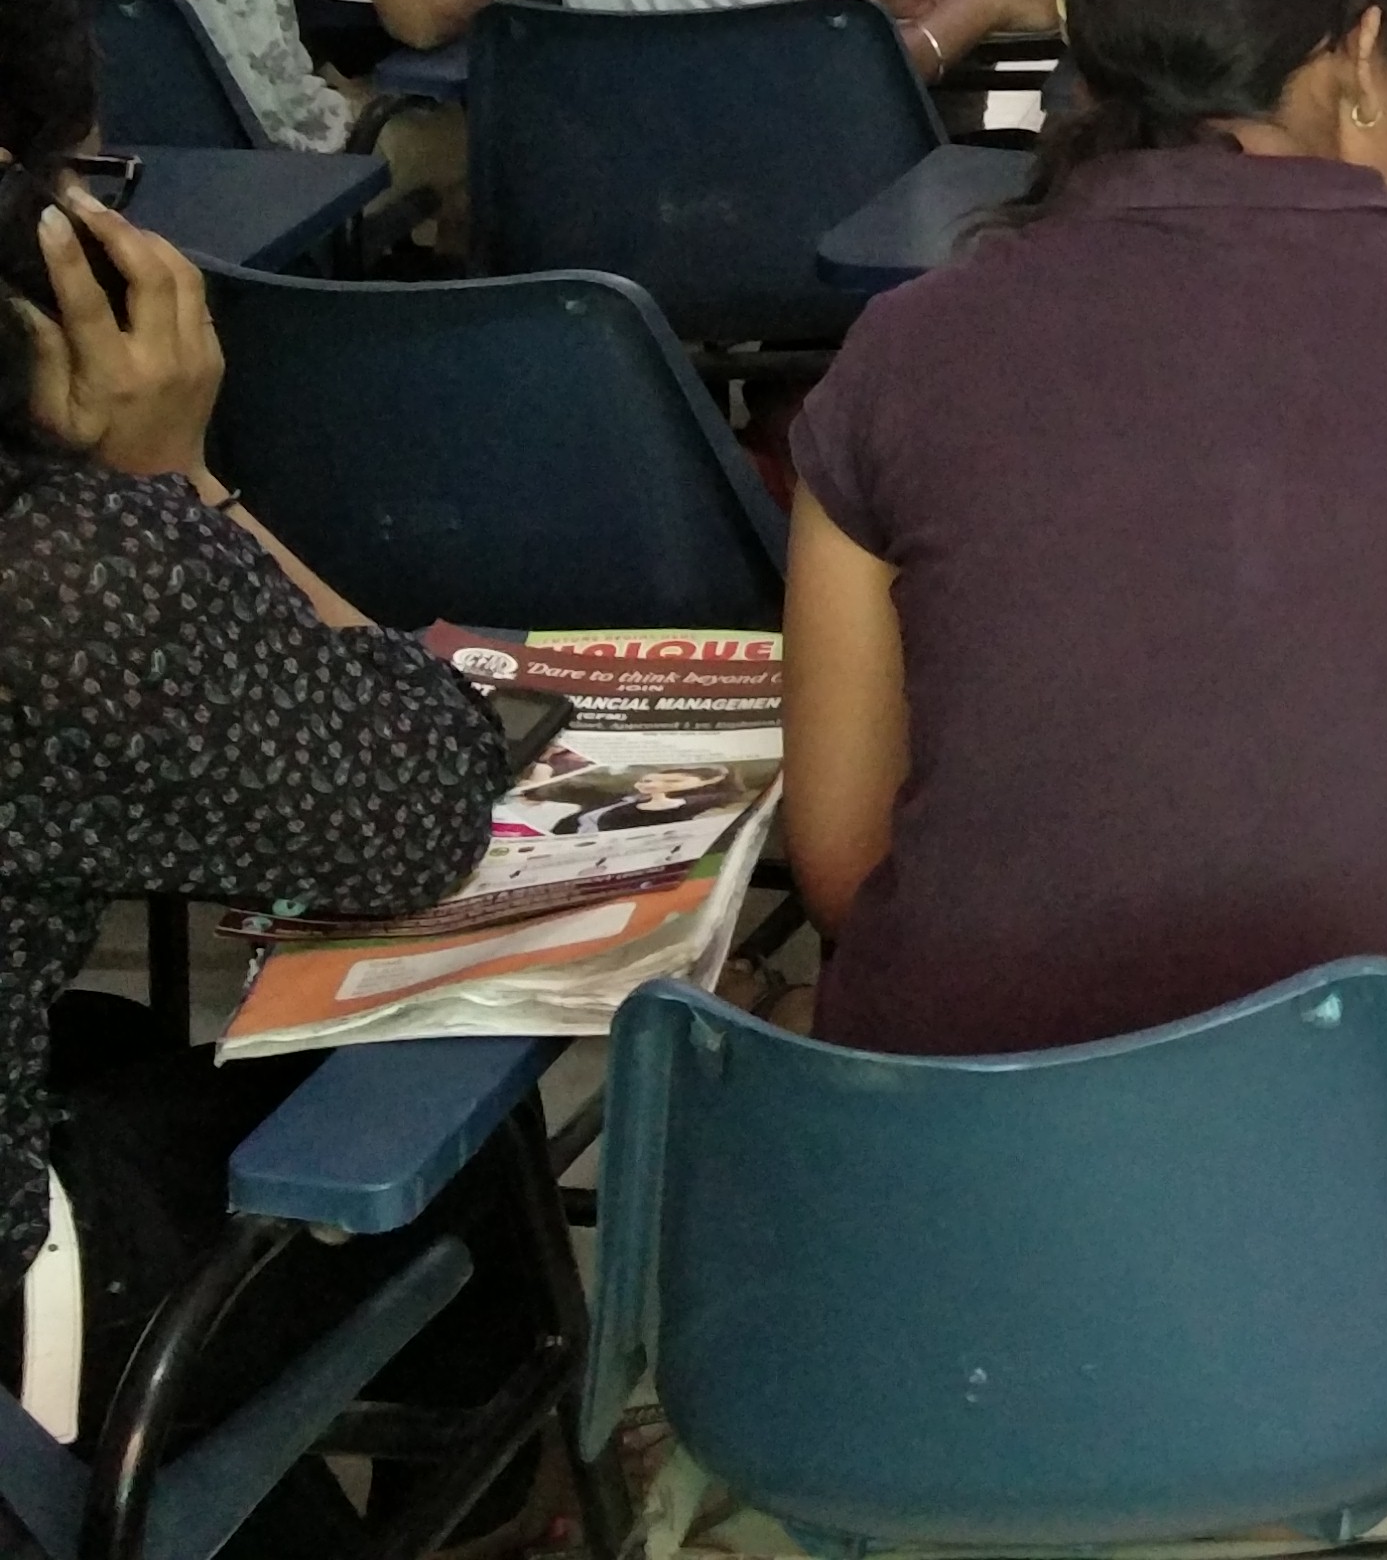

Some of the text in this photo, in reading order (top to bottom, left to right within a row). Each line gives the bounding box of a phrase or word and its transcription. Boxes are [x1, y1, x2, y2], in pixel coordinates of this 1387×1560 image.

[589, 669, 614, 682] to
[618, 670, 682, 685] think
[683, 671, 768, 687] beyond
[616, 684, 665, 692] JOIN
[566, 694, 782, 711] NANCIAL MANAGEMEN
